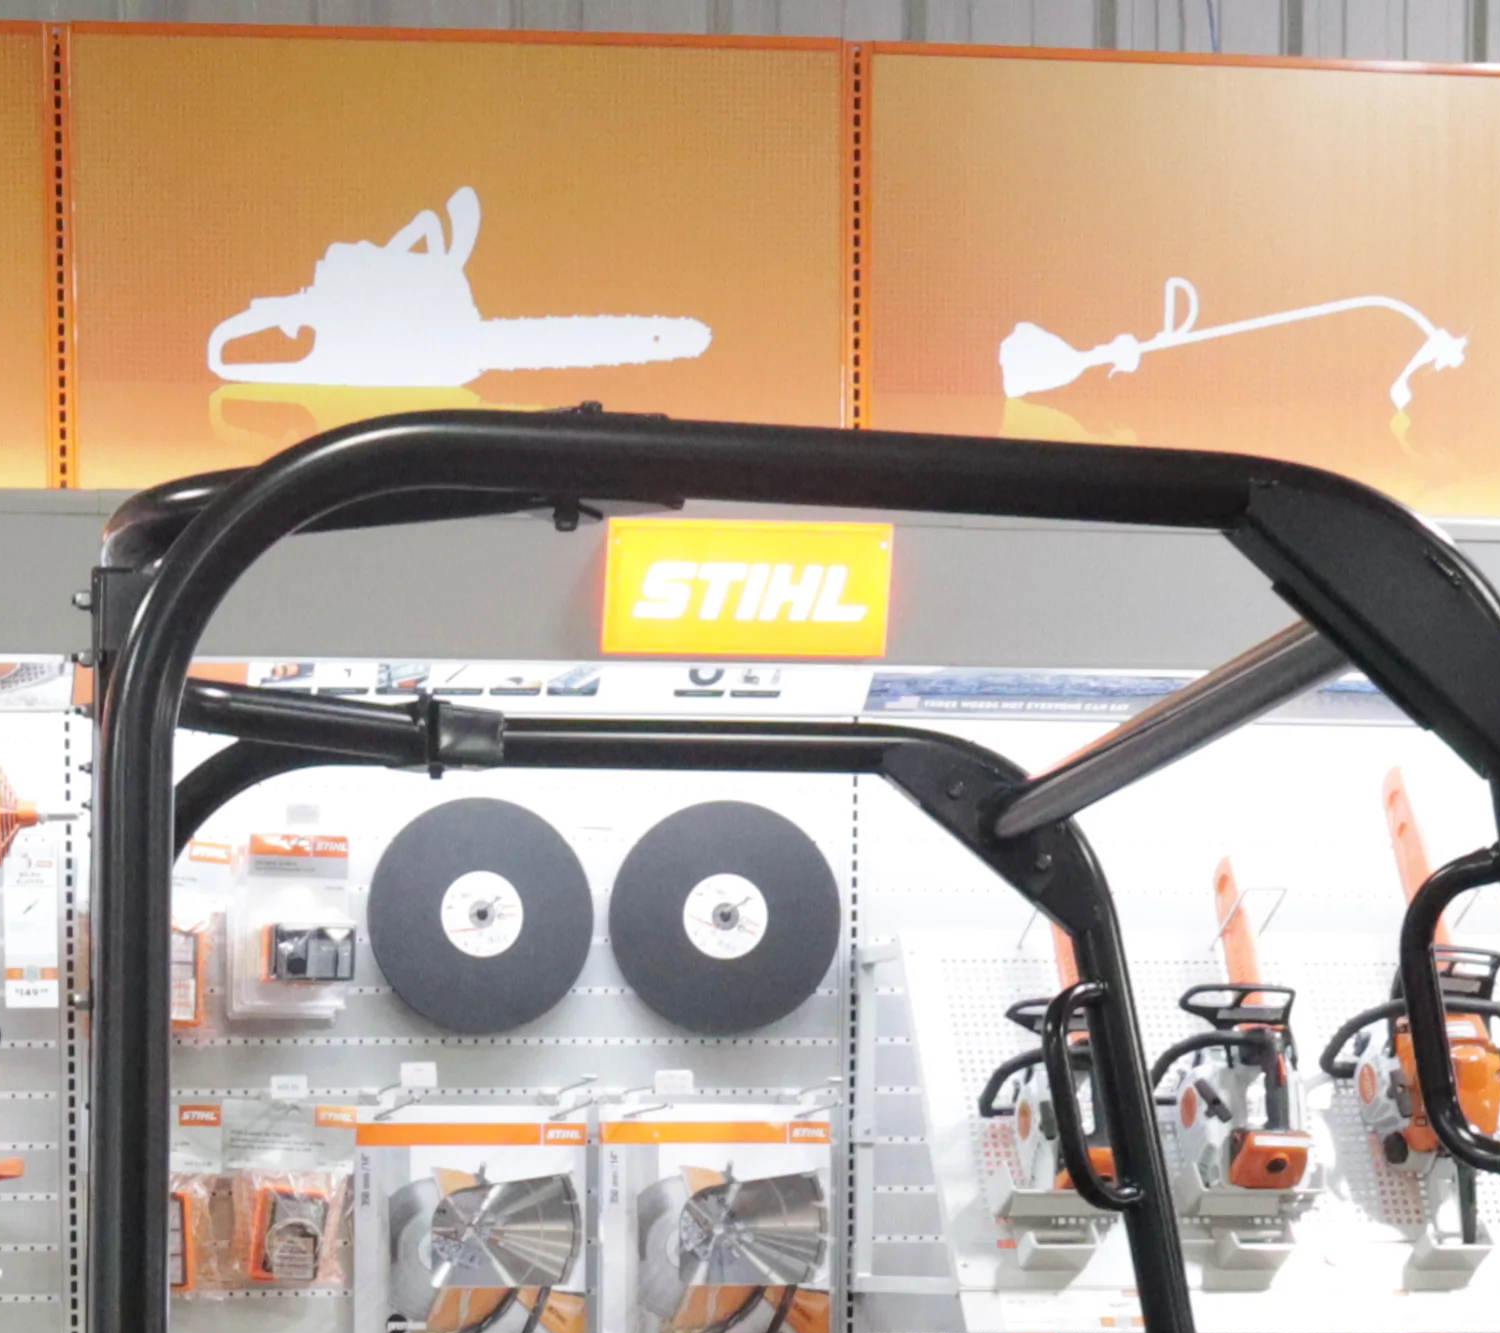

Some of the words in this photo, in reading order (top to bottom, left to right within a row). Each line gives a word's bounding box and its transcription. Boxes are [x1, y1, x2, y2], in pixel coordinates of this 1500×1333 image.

[632, 561, 868, 622] STIHL
[192, 845, 231, 862] STIHL
[315, 840, 348, 855] STIHL
[180, 1110, 217, 1122] STIHL
[547, 1129, 583, 1140] STIHL
[792, 1127, 827, 1138] STIHL
